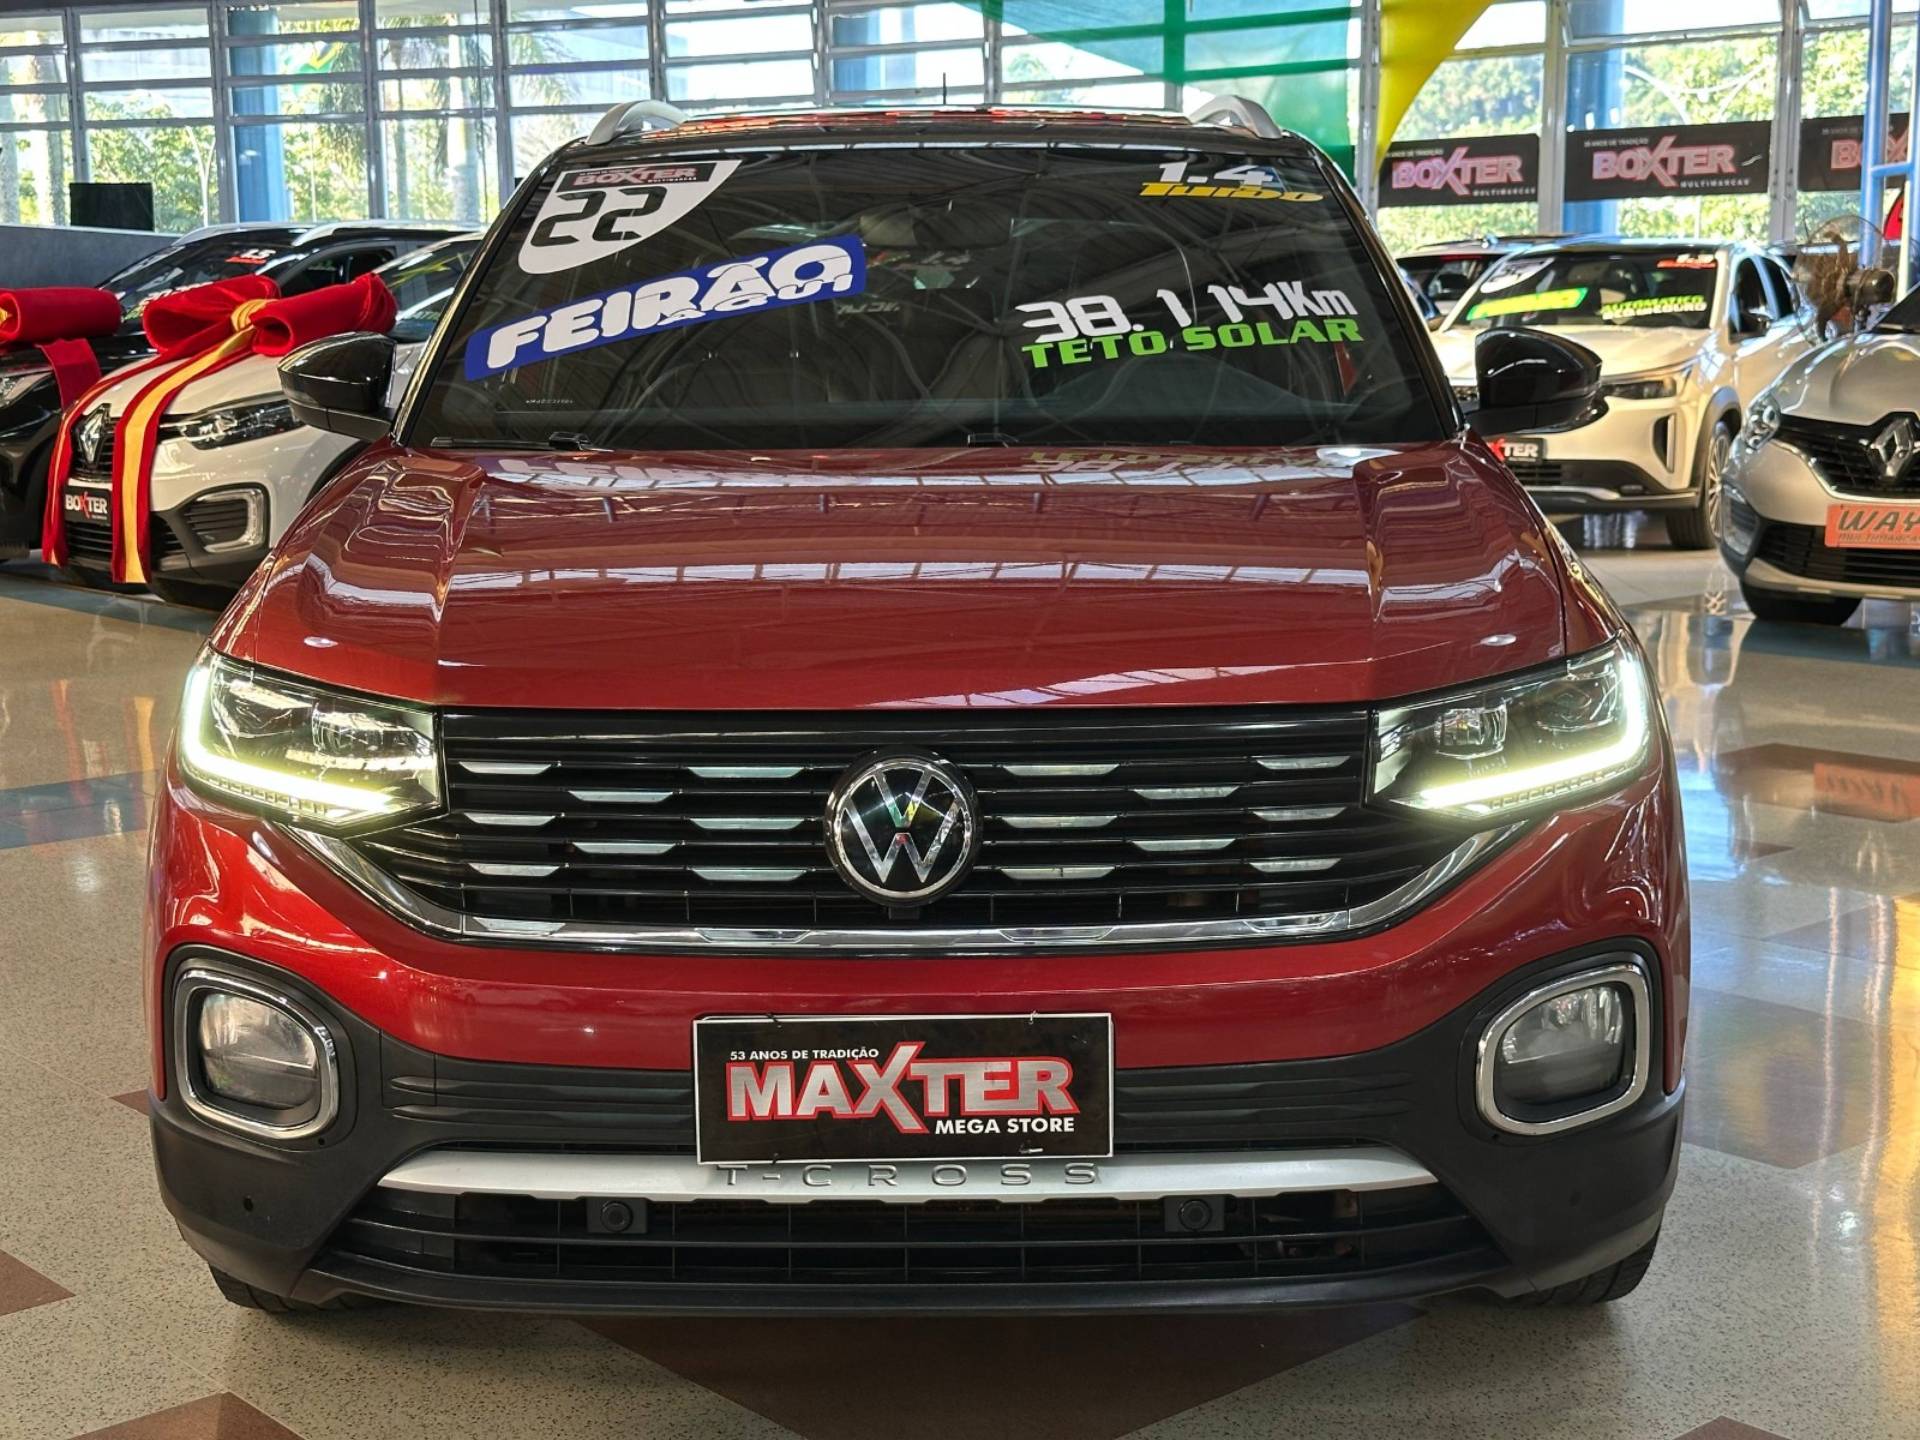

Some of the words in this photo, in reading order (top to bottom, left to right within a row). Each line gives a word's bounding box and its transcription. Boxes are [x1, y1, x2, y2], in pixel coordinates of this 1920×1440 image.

[1159, 161, 1274, 191] 1.4
[1391, 146, 1524, 197] BOXTER
[1592, 135, 1737, 188] BOXTER
[572, 167, 698, 187] BOXTER
[1139, 182, 1324, 202] Turbo
[530, 185, 668, 247] 22
[487, 243, 854, 370] FEIRÃO
[1021, 330, 1167, 369] TETO
[1182, 317, 1365, 351] SOLAR
[1486, 437, 1539, 462] XTER
[65, 491, 108, 519] BOXTER
[729, 1050, 747, 1061] 53
[749, 1049, 788, 1060] ANOS
[791, 1050, 809, 1060] DE
[812, 1046, 880, 1061] TRADIÇÃO
[725, 1040, 1081, 1135] MAXTER
[934, 1118, 1001, 1135] MEGA
[1006, 1117, 1075, 1134] STORE
[715, 1162, 1101, 1188] T-CROSS
